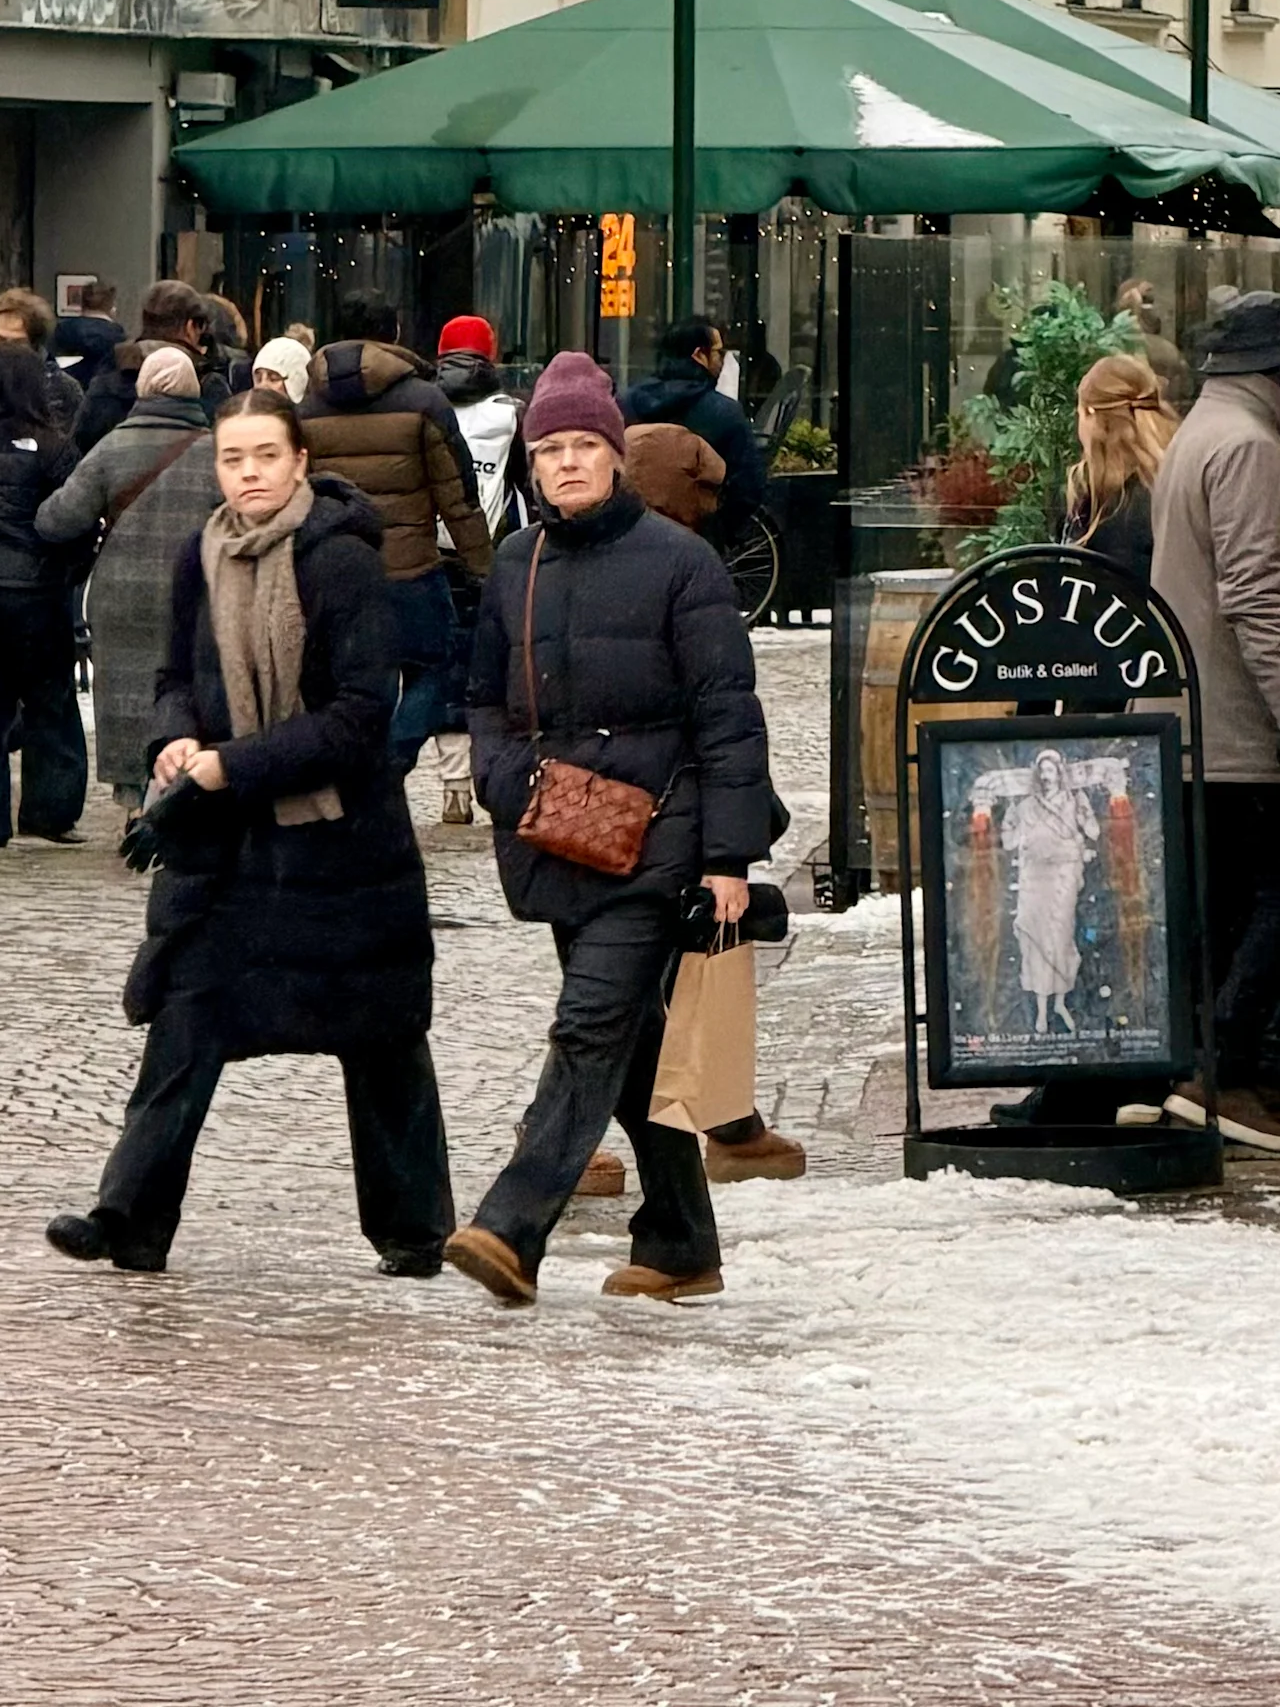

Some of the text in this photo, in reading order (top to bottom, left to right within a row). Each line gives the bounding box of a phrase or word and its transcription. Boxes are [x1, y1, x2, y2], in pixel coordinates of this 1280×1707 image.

[931, 574, 1169, 692] GUSTUS
[997, 662, 1098, 679] Butik & Galleri
